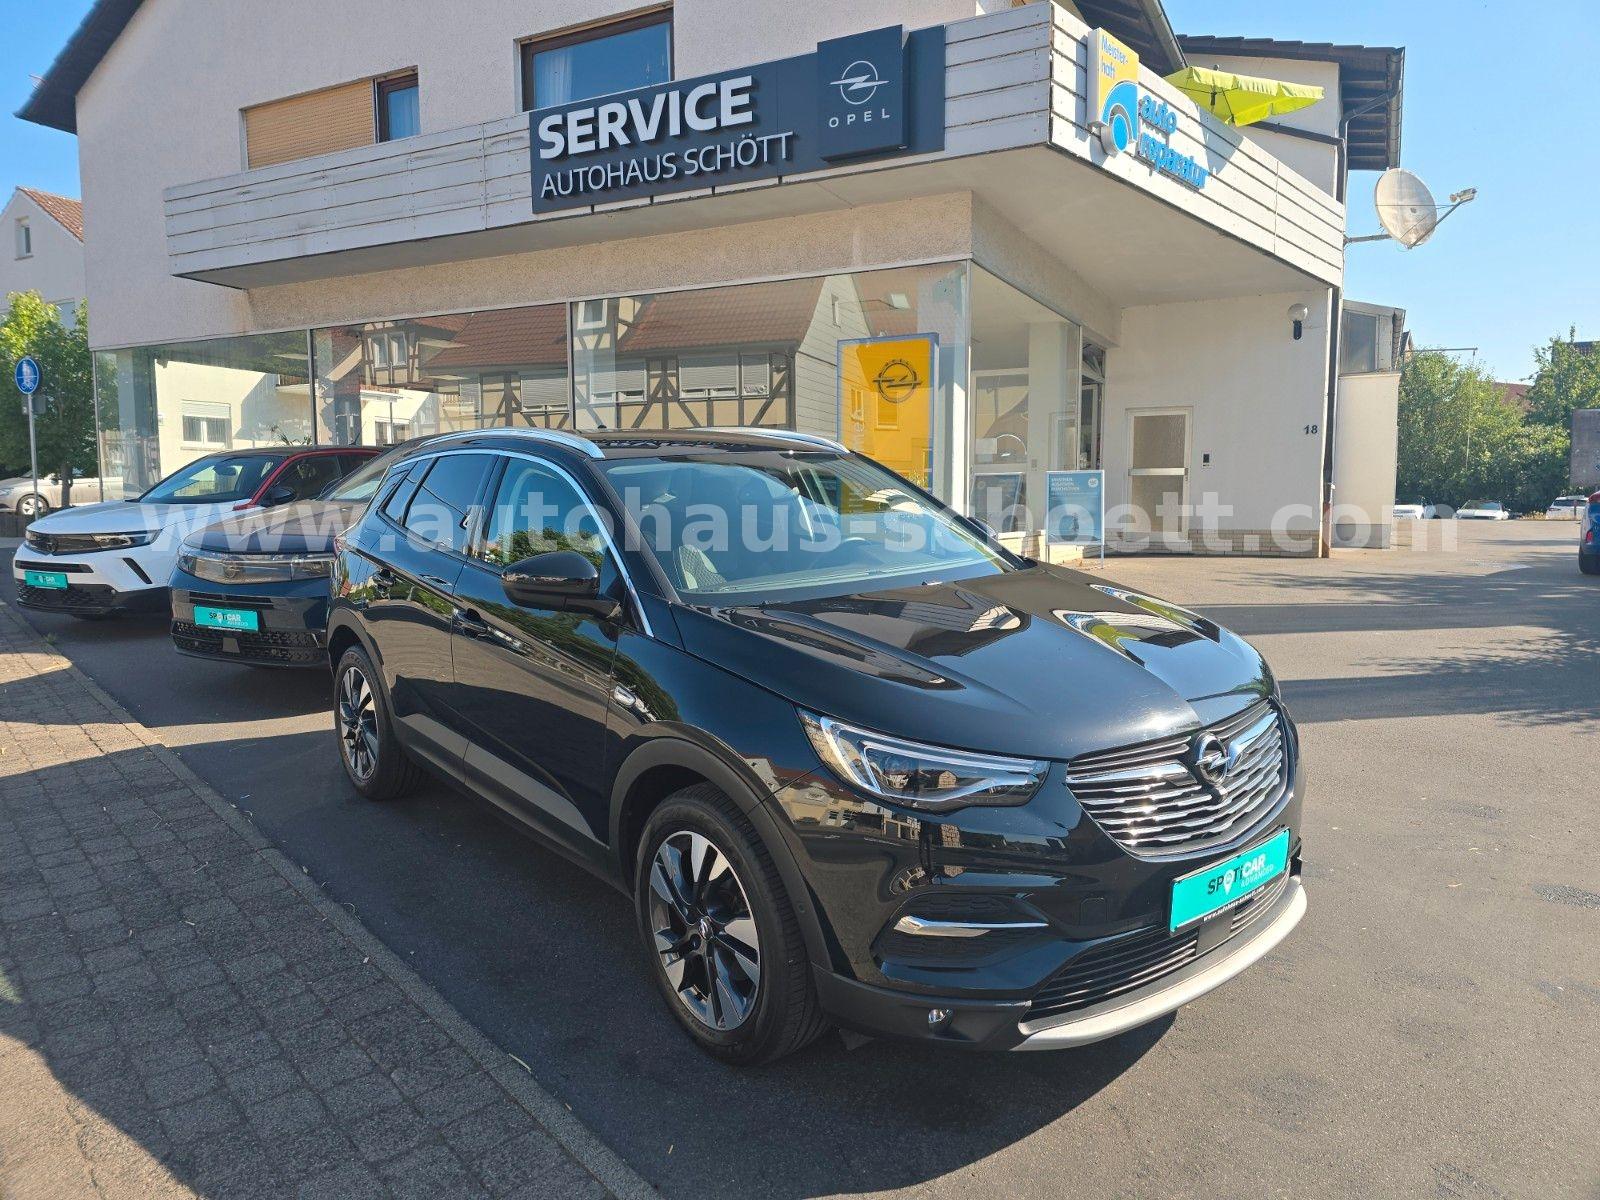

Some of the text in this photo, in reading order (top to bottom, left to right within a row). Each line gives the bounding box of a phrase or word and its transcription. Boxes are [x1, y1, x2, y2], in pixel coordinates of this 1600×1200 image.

[538, 75, 754, 161] SERVICE
[828, 108, 891, 129] OPEL
[1140, 95, 1177, 134] auto
[540, 130, 794, 199] AUTOHAUS SCHÖTT
[1303, 424, 1319, 435] 18
